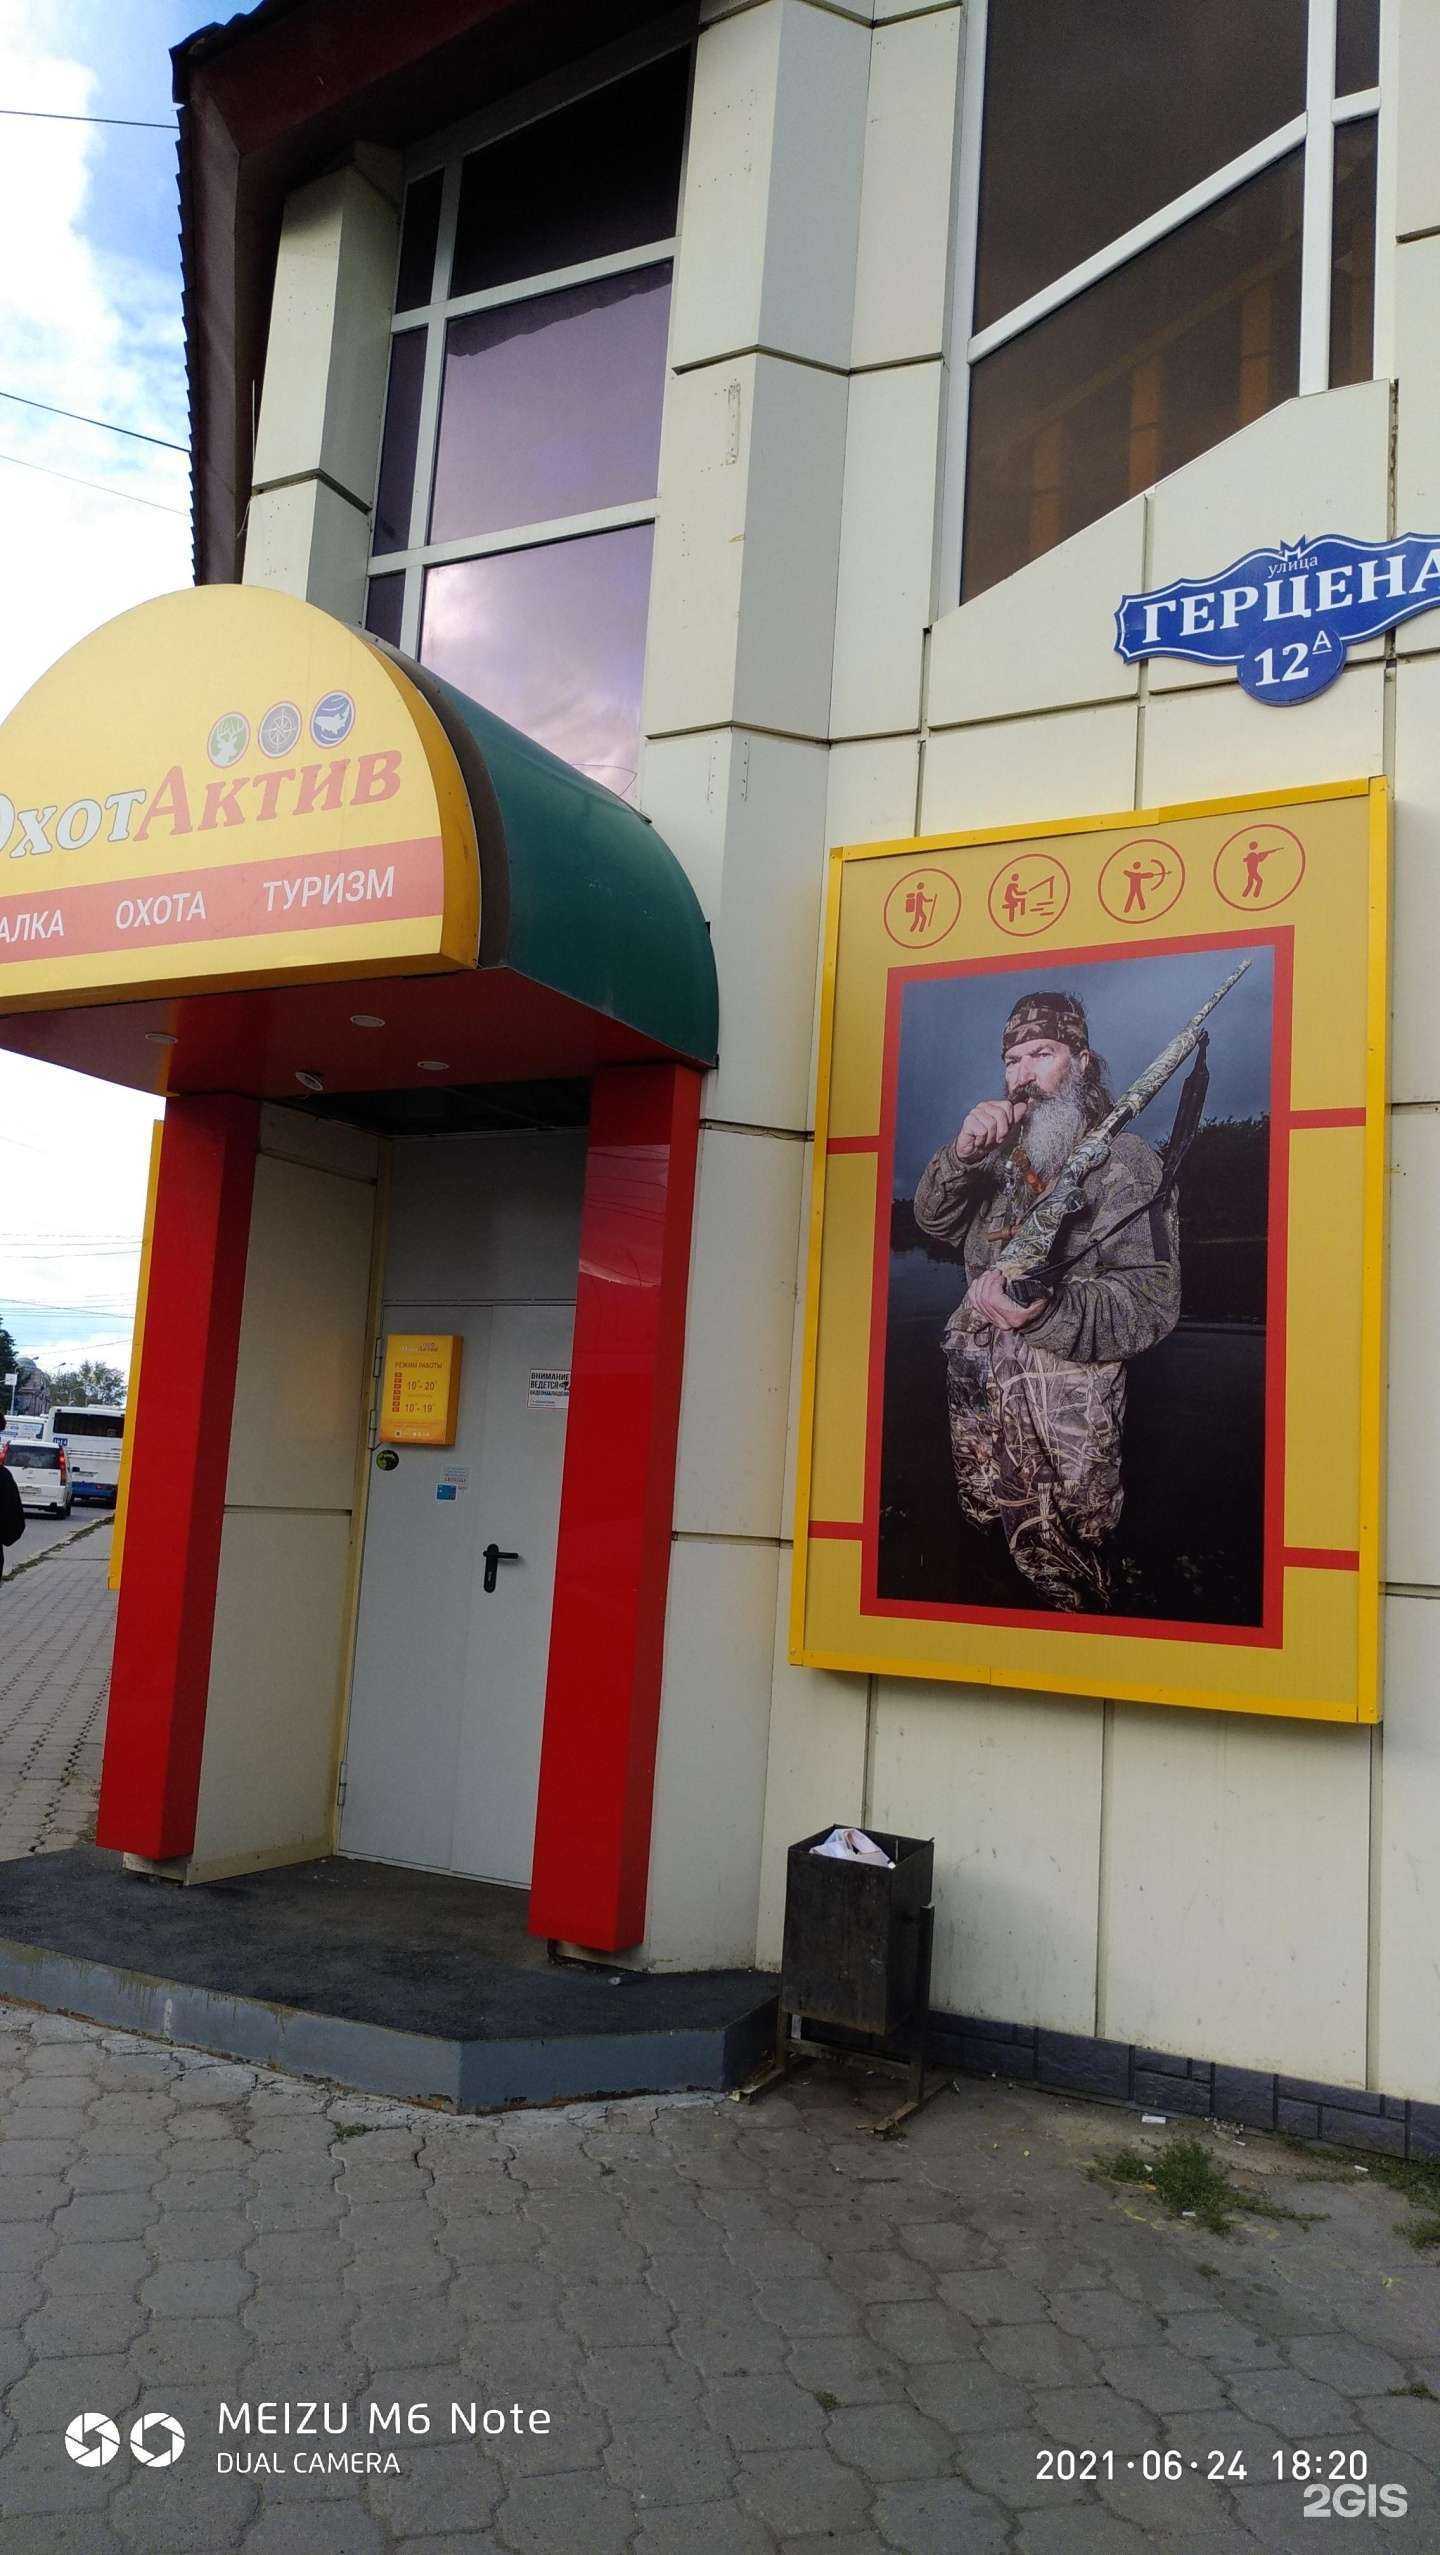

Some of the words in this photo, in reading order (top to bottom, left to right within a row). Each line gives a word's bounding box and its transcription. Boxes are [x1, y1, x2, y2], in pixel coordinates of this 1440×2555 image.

[1267, 555, 1318, 579] улица
[115, 890, 207, 930] ОХОТА
[263, 865, 395, 912] ТУРИЗМ
